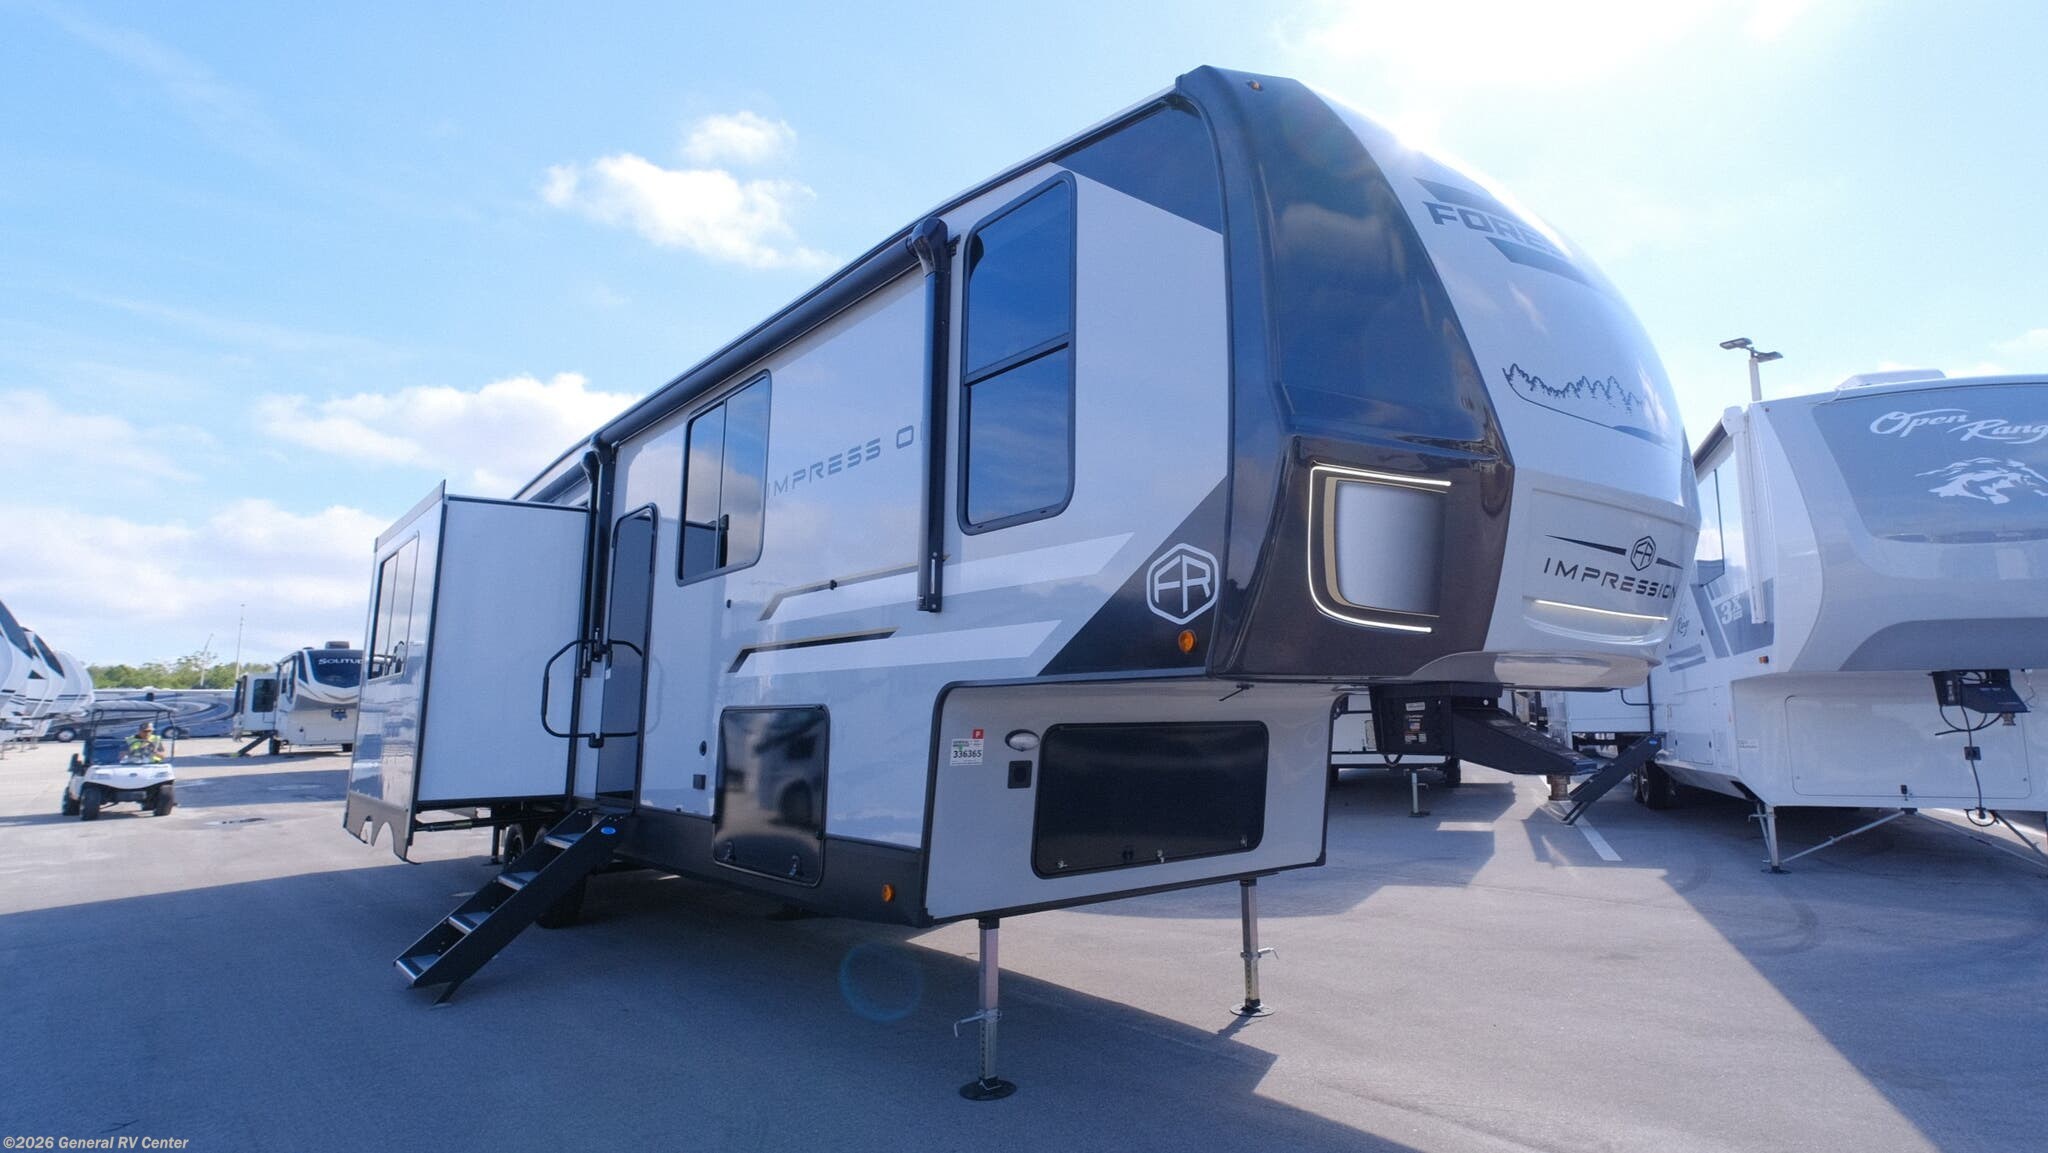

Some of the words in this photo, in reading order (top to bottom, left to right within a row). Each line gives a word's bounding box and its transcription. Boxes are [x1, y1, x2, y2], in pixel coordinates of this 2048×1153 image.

[1870, 408, 1970, 438] Open
[1543, 557, 1677, 600] IMPRESSION
[953, 750, 982, 759] 336365
